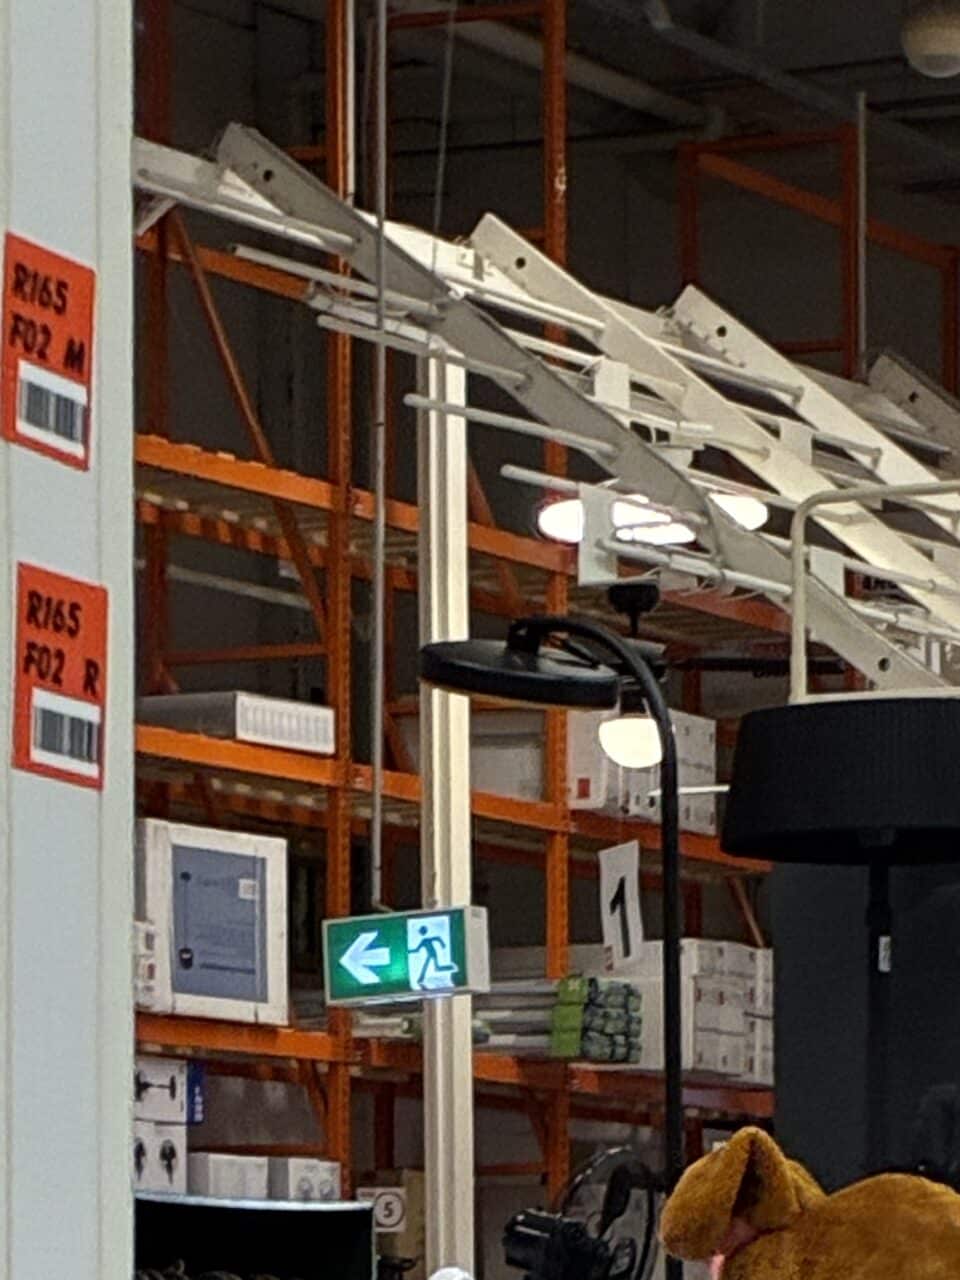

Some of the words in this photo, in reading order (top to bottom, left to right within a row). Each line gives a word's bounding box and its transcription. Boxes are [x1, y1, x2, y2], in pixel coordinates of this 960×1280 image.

[12, 262, 69, 316] R165
[9, 311, 52, 361] F02
[63, 338, 86, 374] M
[26, 589, 82, 639] R165
[23, 640, 65, 687] F02
[83, 658, 100, 697] R
